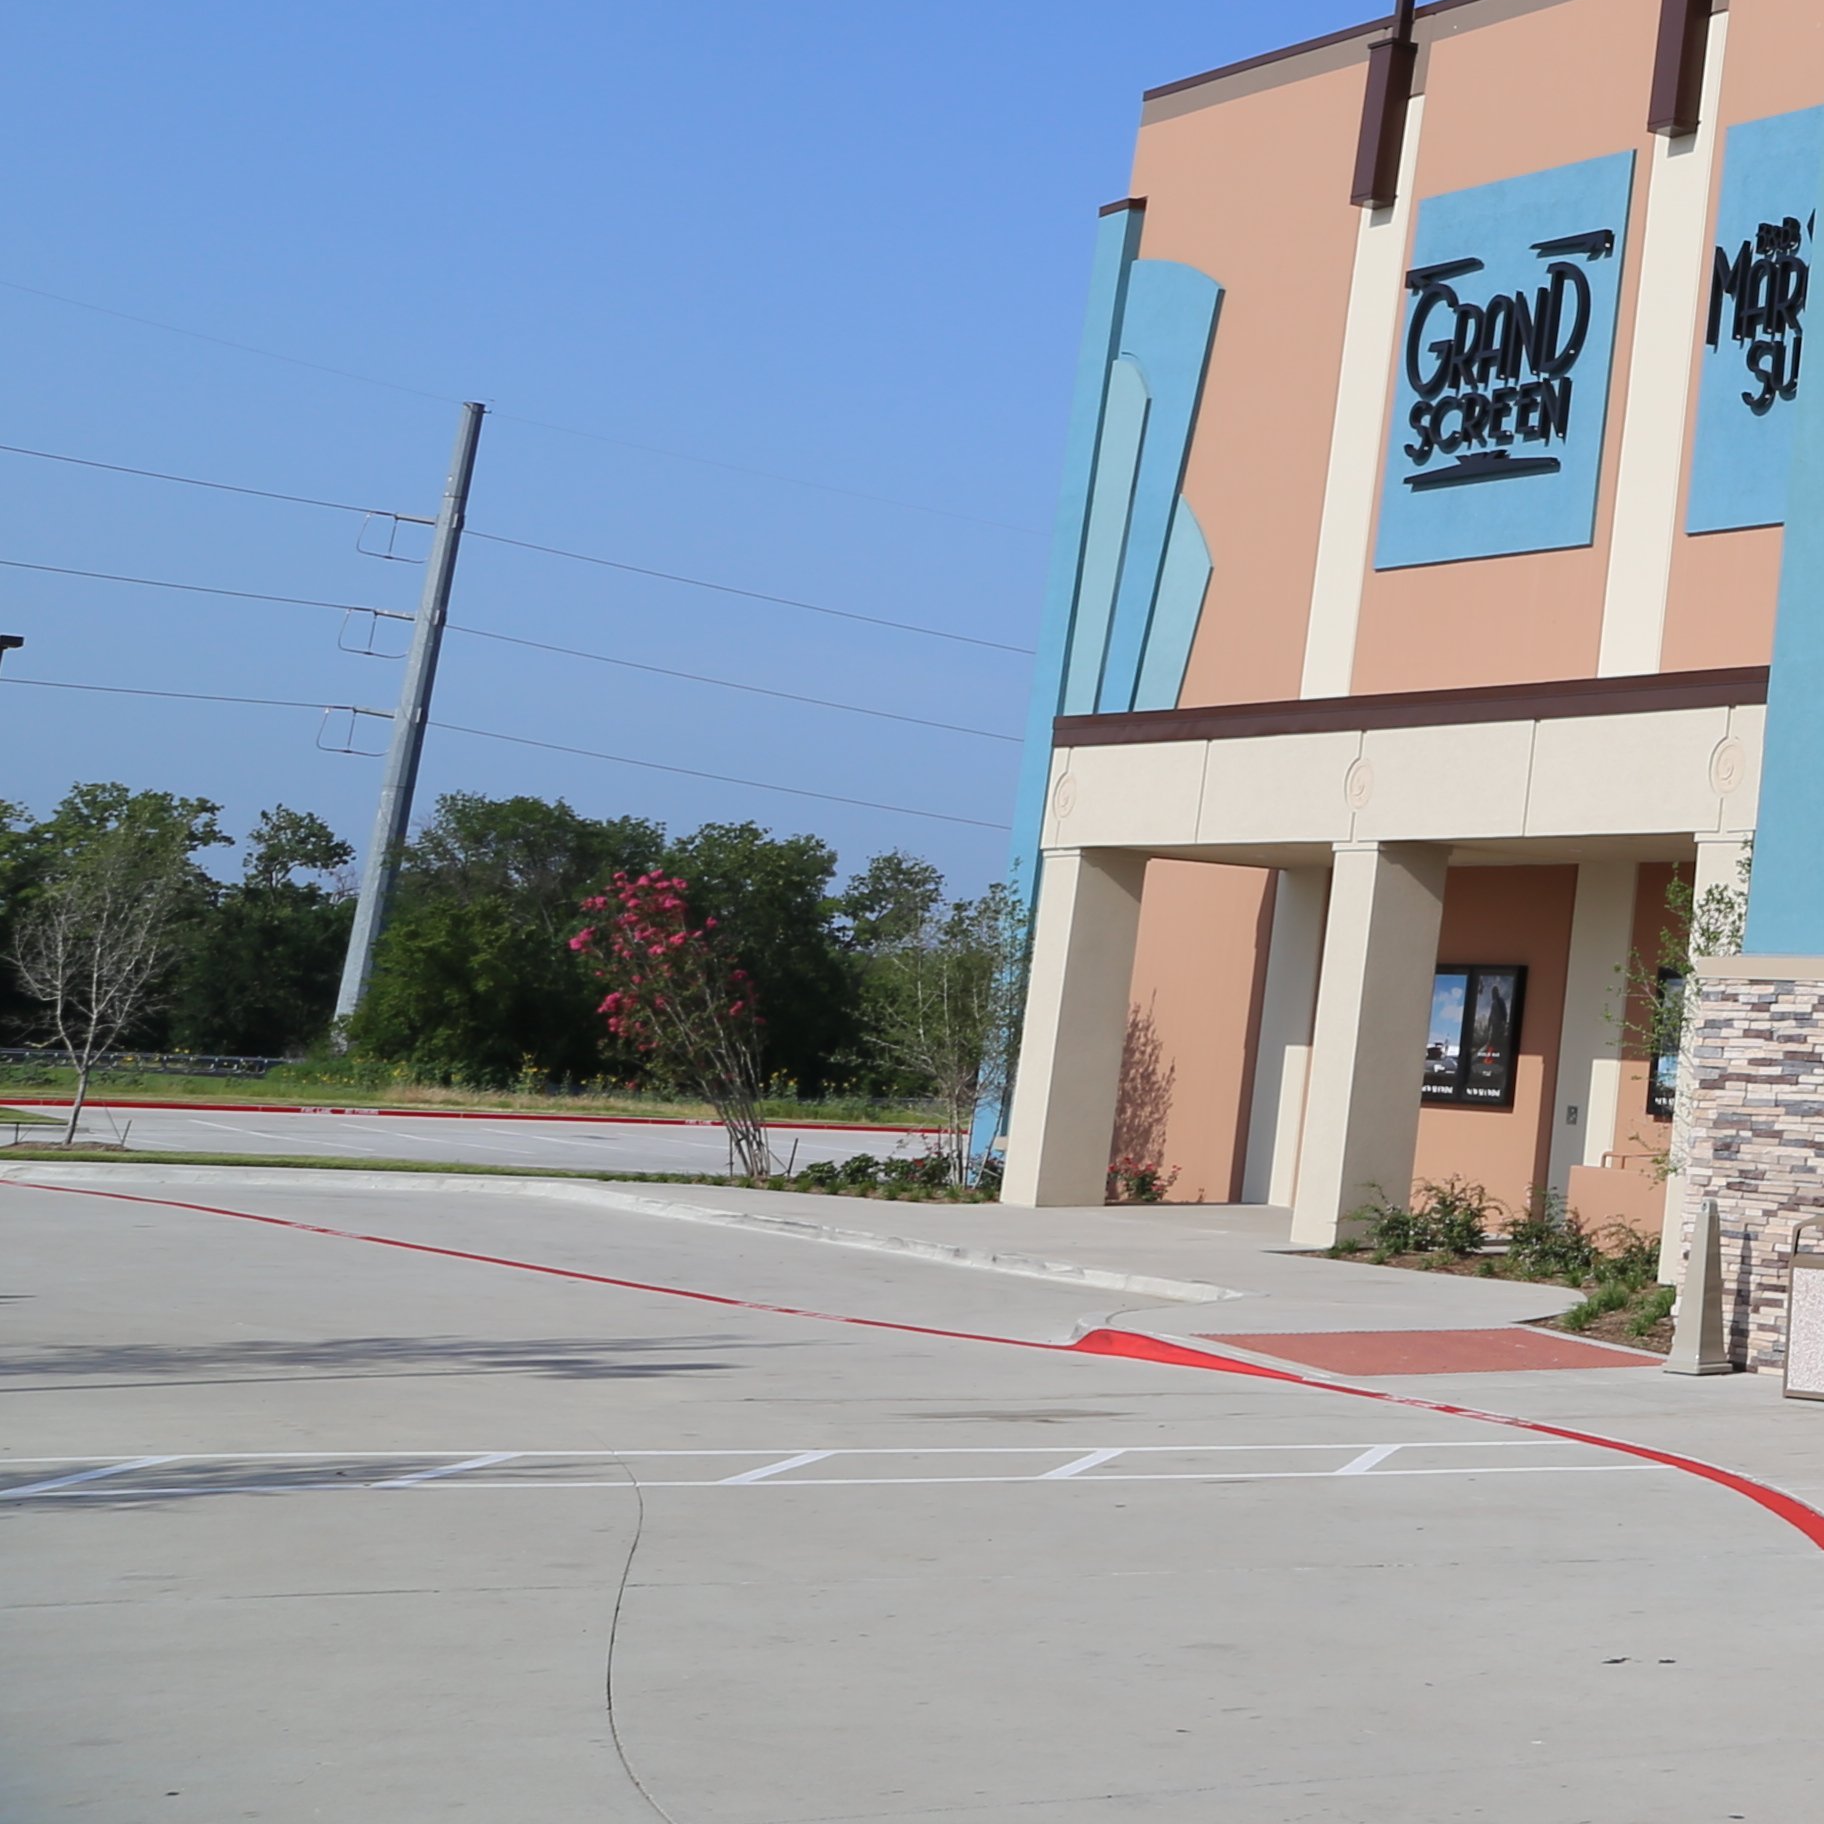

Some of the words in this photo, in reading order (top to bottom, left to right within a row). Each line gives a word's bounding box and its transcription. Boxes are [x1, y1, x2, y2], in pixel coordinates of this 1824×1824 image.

[1405, 261, 1591, 398] GRAND
[1706, 240, 1809, 345] MAR
[1404, 377, 1573, 465] SCREEN
